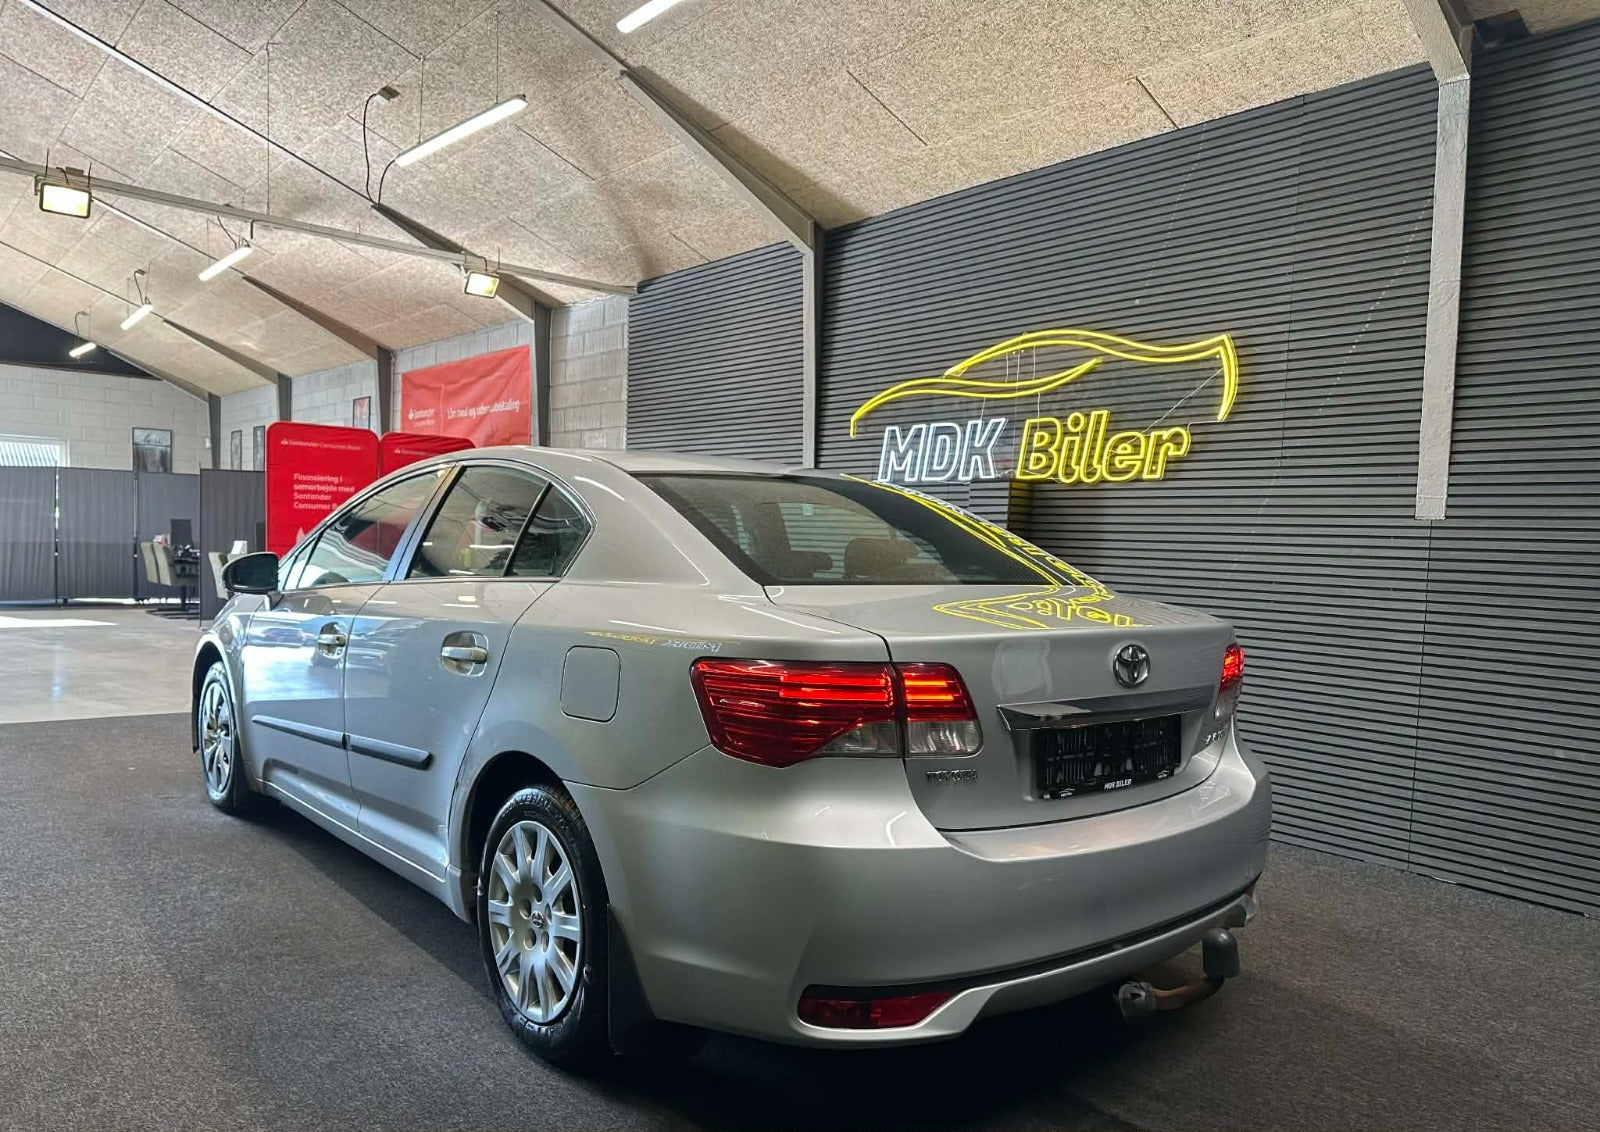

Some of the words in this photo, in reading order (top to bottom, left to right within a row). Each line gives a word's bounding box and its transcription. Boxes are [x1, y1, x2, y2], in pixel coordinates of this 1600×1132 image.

[877, 417, 1007, 483] MDK
[1016, 409, 1191, 484] Biler
[293, 473, 339, 484] Finansiering
[293, 484, 338, 493] samarbejde
[293, 492, 332, 501] Santander
[293, 501, 331, 510] Consumer
